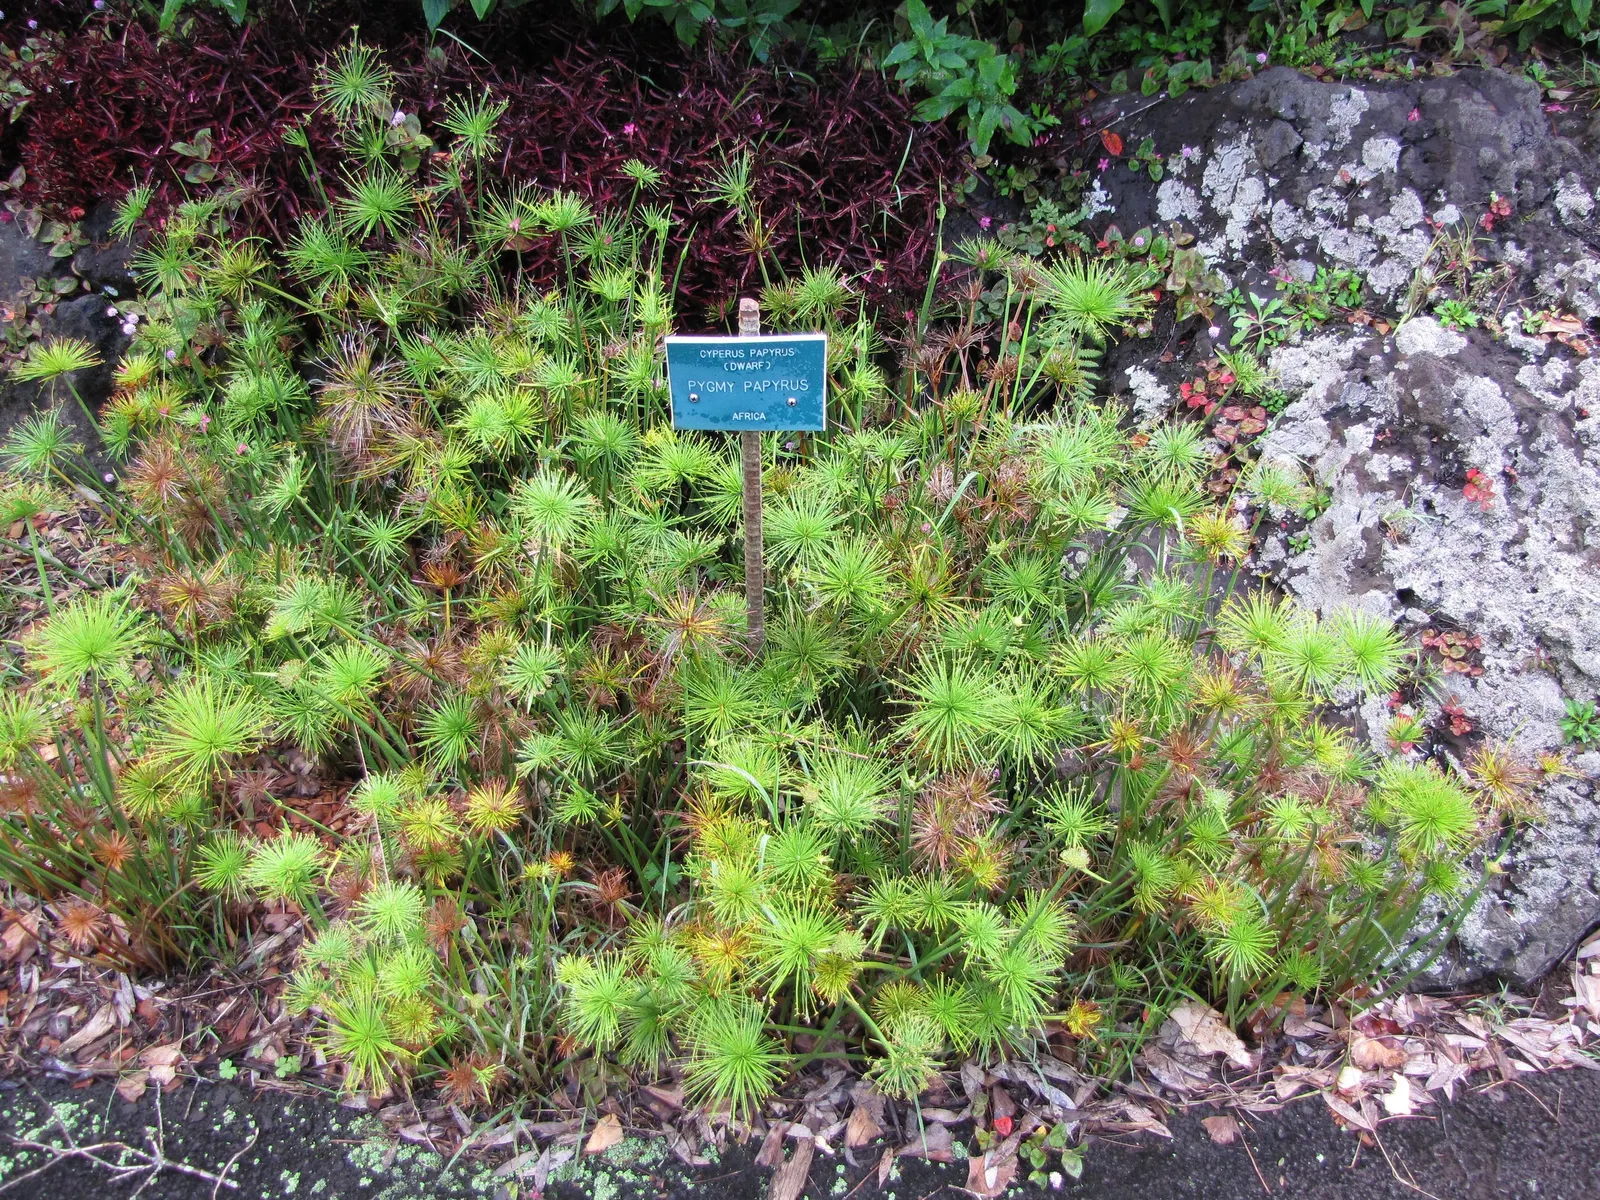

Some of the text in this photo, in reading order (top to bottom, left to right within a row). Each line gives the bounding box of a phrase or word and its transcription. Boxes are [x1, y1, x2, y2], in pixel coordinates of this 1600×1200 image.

[699, 348, 795, 359] CYPERUS PAPYRUS
[723, 361, 771, 371] (DWARF)
[688, 379, 809, 393] PYGMY PAPYRUS
[732, 412, 766, 421] AFRICA
